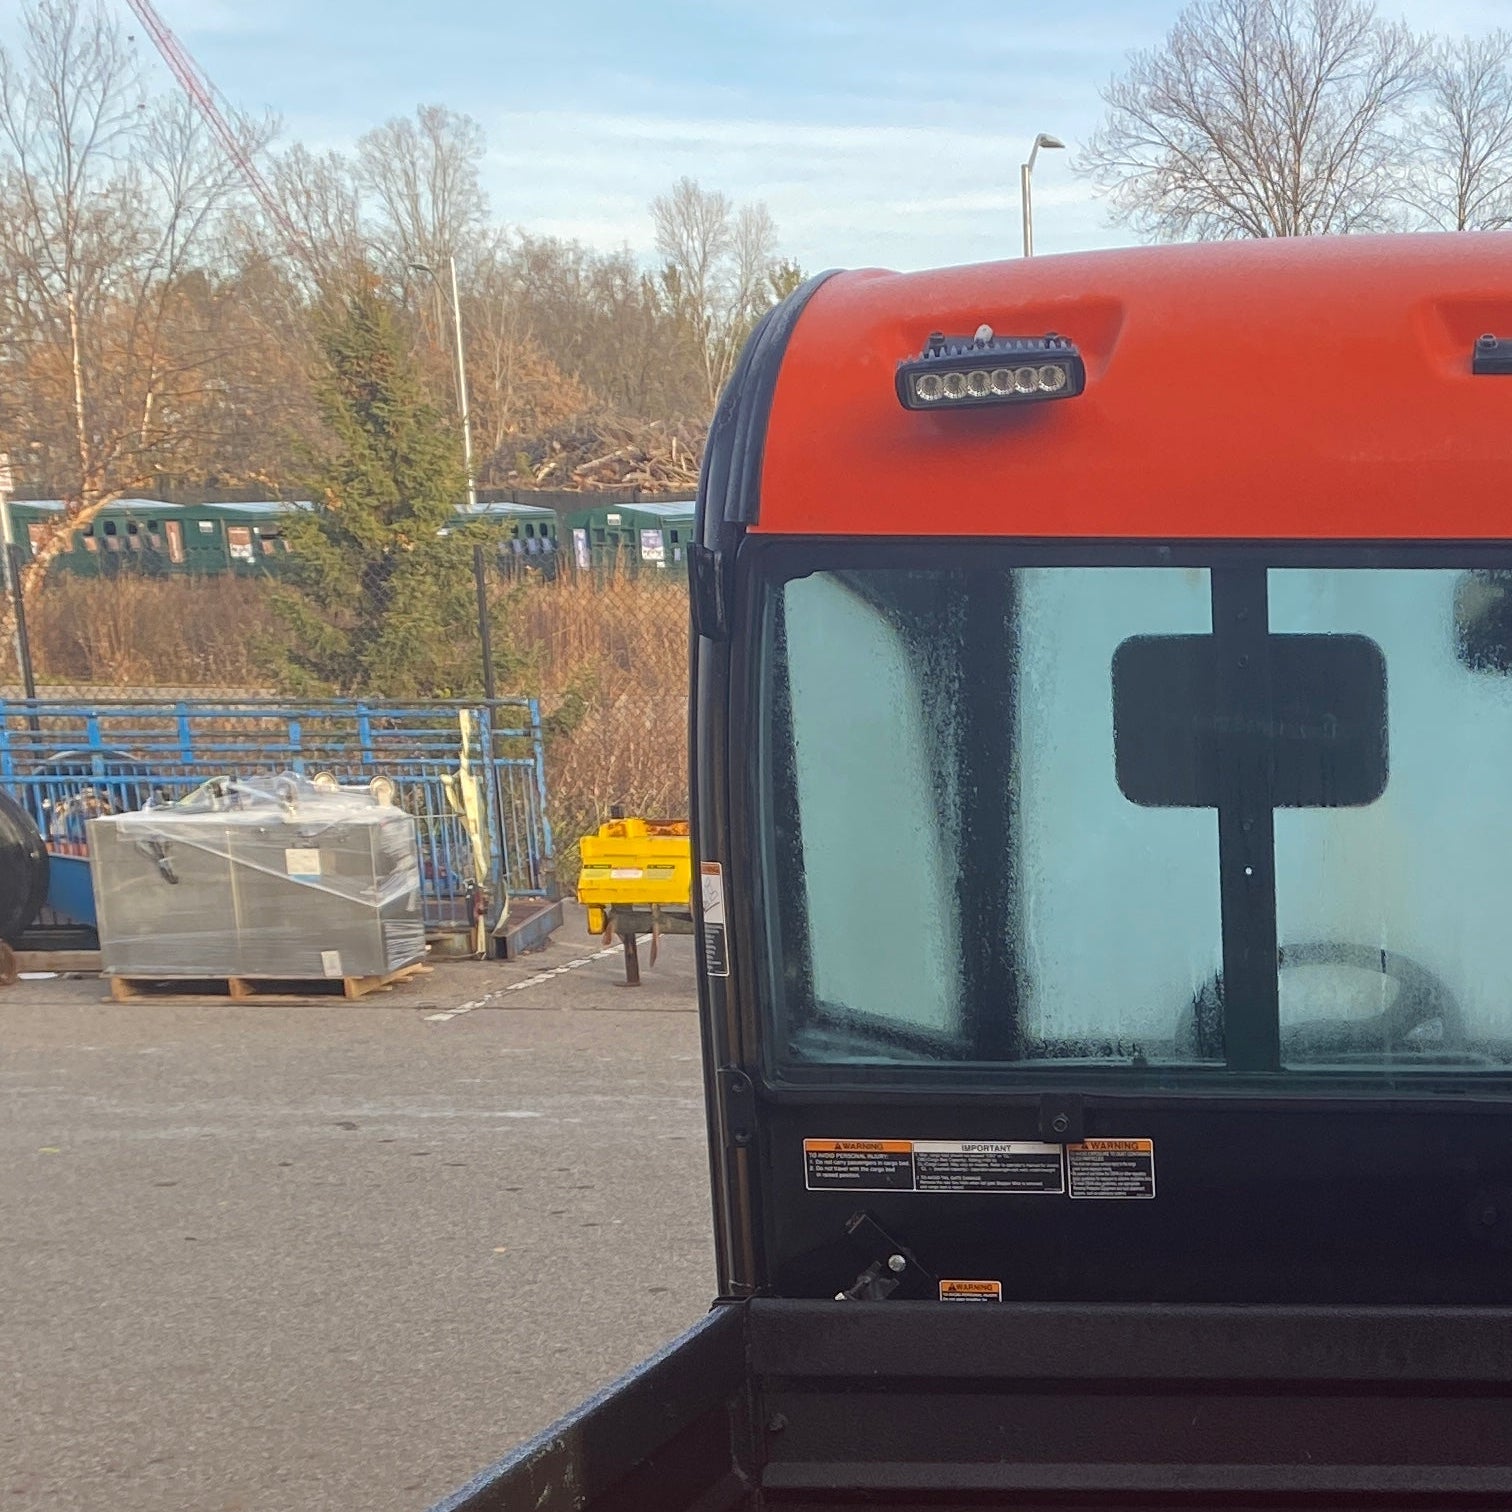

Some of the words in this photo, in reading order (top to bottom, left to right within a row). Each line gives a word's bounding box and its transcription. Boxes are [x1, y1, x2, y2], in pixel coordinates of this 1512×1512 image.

[843, 1142, 885, 1151] WARNING
[961, 1144, 1012, 1152] IMPORTANT
[1089, 1141, 1139, 1150] WARNING
